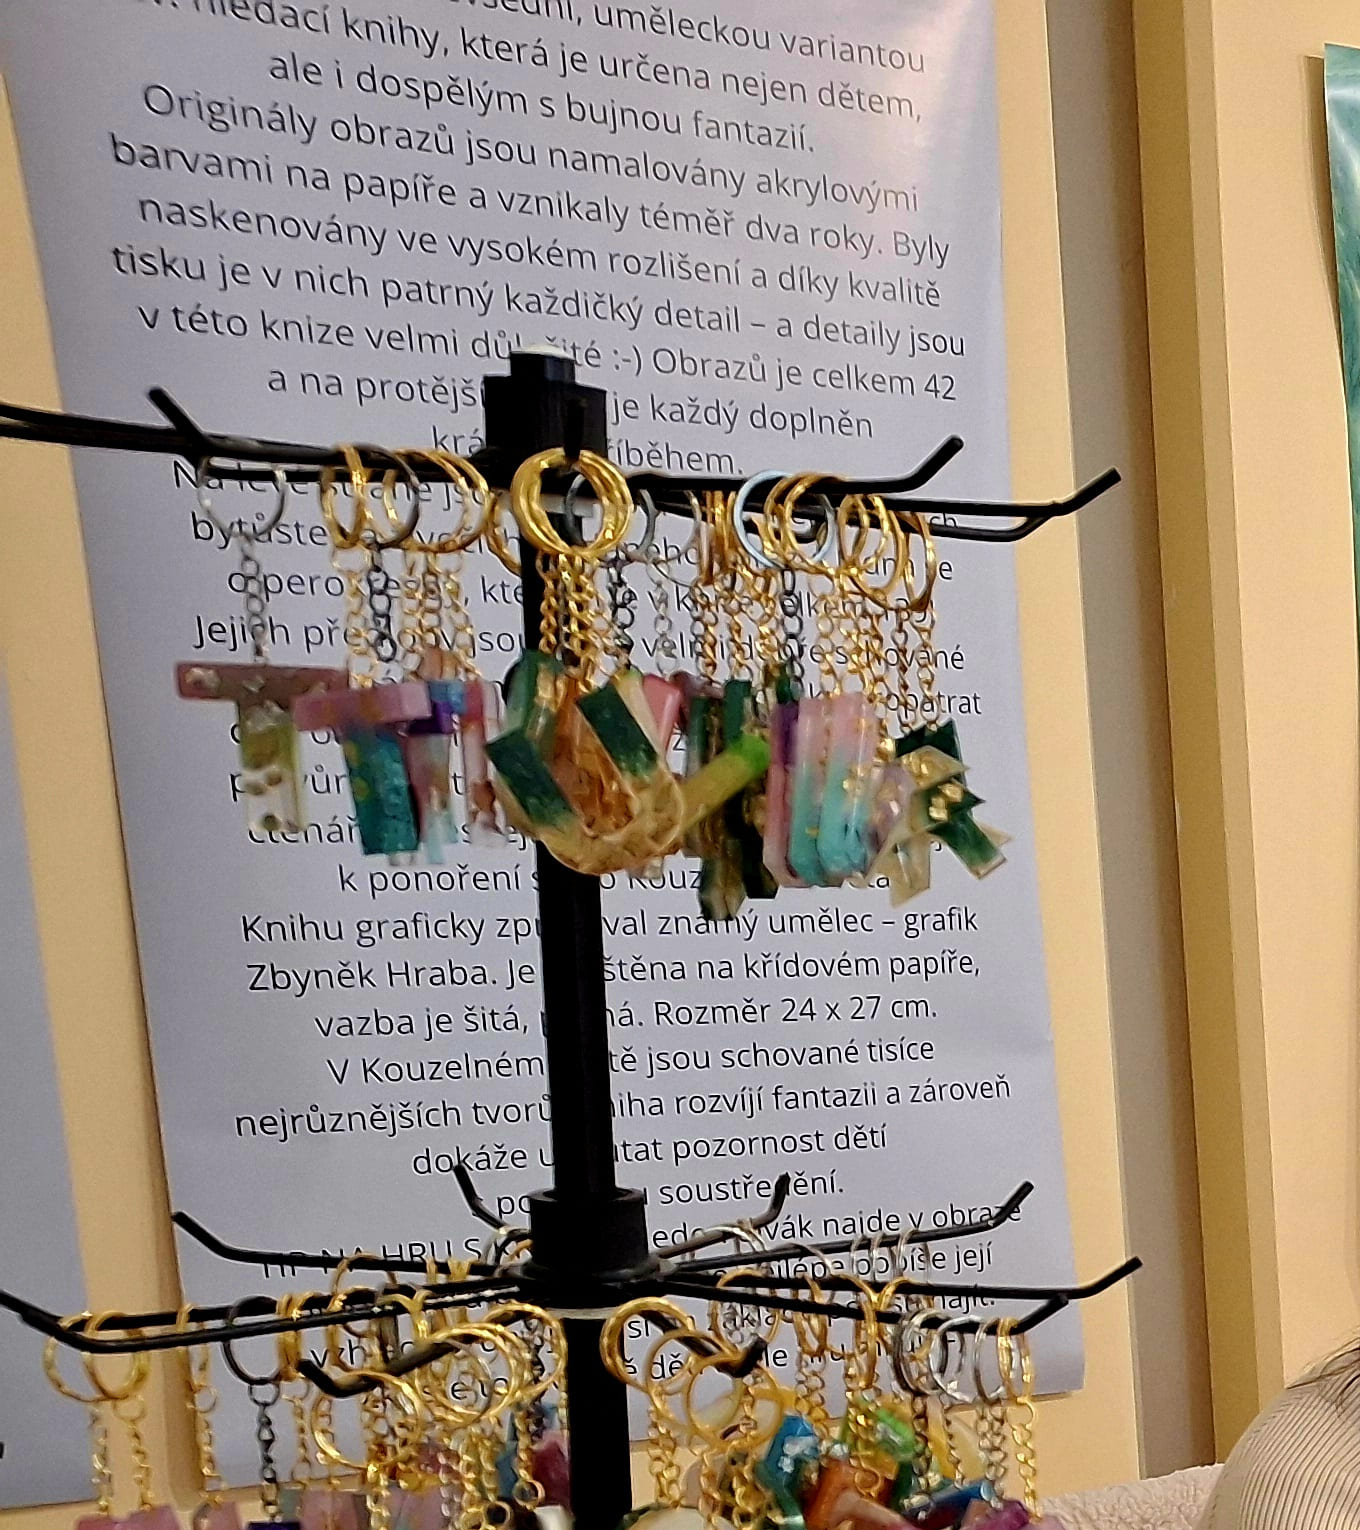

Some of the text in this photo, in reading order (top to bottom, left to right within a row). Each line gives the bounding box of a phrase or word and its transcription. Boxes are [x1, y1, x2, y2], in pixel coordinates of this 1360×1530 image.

[343, 7, 449, 58] knihy,
[461, 26, 548, 68] která
[559, 41, 588, 78] je
[600, 52, 711, 90] určena
[721, 70, 807, 106] nejen
[818, 79, 922, 123] dětem,
[594, 3, 770, 51] uměleckou
[780, 30, 925, 74] variantou
[269, 51, 815, 153] ale i dospělým s bujnou fantazií.
[143, 84, 919, 213] Originály obrazů jsou namalovány akrylovými
[109, 132, 950, 269] barvami na papíře a vznikaly téměř dva roky. Byly
[138, 199, 941, 308] naskenovány ve vysokém rozlišení a díky kvalitě
[112, 244, 206, 282] tisku
[218, 254, 251, 292] je
[262, 264, 282, 289] v
[295, 265, 369, 299] nich
[383, 277, 494, 316] patrný
[505, 283, 642, 331] každičký
[655, 301, 740, 334] detail
[776, 316, 793, 339] a
[803, 313, 901, 357] detaily
[908, 326, 965, 358] jsou
[138, 305, 160, 330] v
[172, 303, 249, 338] této
[261, 309, 354, 348] knize
[365, 322, 460, 358] velmi
[653, 346, 767, 383] Obrazů
[775, 358, 802, 391] je
[813, 364, 915, 396] celkem
[925, 374, 957, 401] 42
[268, 369, 287, 392] a
[300, 371, 342, 396] na
[611, 392, 640, 425] je
[650, 393, 739, 431] každý
[749, 406, 873, 438] doplněn
[607, 438, 743, 475] íběhem.
[836, 640, 965, 670] shované
[338, 863, 521, 899] k ponoření
[241, 912, 344, 942] Knihu
[356, 911, 485, 948] graficky
[768, 907, 874, 933] umělec
[904, 906, 978, 939] grafik
[246, 961, 376, 997] Zbyněk
[388, 959, 498, 987] Hraba.
[505, 958, 536, 990] Je
[697, 958, 734, 980] na
[744, 951, 880, 979] křídovém
[889, 949, 981, 983] papíře,
[315, 1008, 415, 1038] vazba
[423, 1007, 453, 1041] je
[464, 1004, 529, 1035] šitá,
[655, 999, 770, 1027] Rozměr
[781, 997, 817, 1023] 24
[826, 1002, 841, 1021] x
[850, 995, 881, 1020] 27
[890, 998, 938, 1019] cm.
[326, 1058, 350, 1085] V
[361, 1052, 545, 1084] Kouzelném
[646, 1046, 710, 1078] jsou
[721, 1039, 860, 1069] schované
[866, 1036, 935, 1063] tisíce
[235, 1100, 462, 1143] nejrůznějších
[674, 1085, 765, 1118] rozvíjí
[772, 1082, 877, 1111] fantazii
[886, 1086, 900, 1106] a
[908, 1074, 1010, 1103] zároveň
[413, 1143, 528, 1175] dokáže
[673, 1127, 825, 1166] pozornost
[834, 1123, 888, 1151] dětí
[909, 1210, 924, 1229] v
[955, 1242, 992, 1273] její
